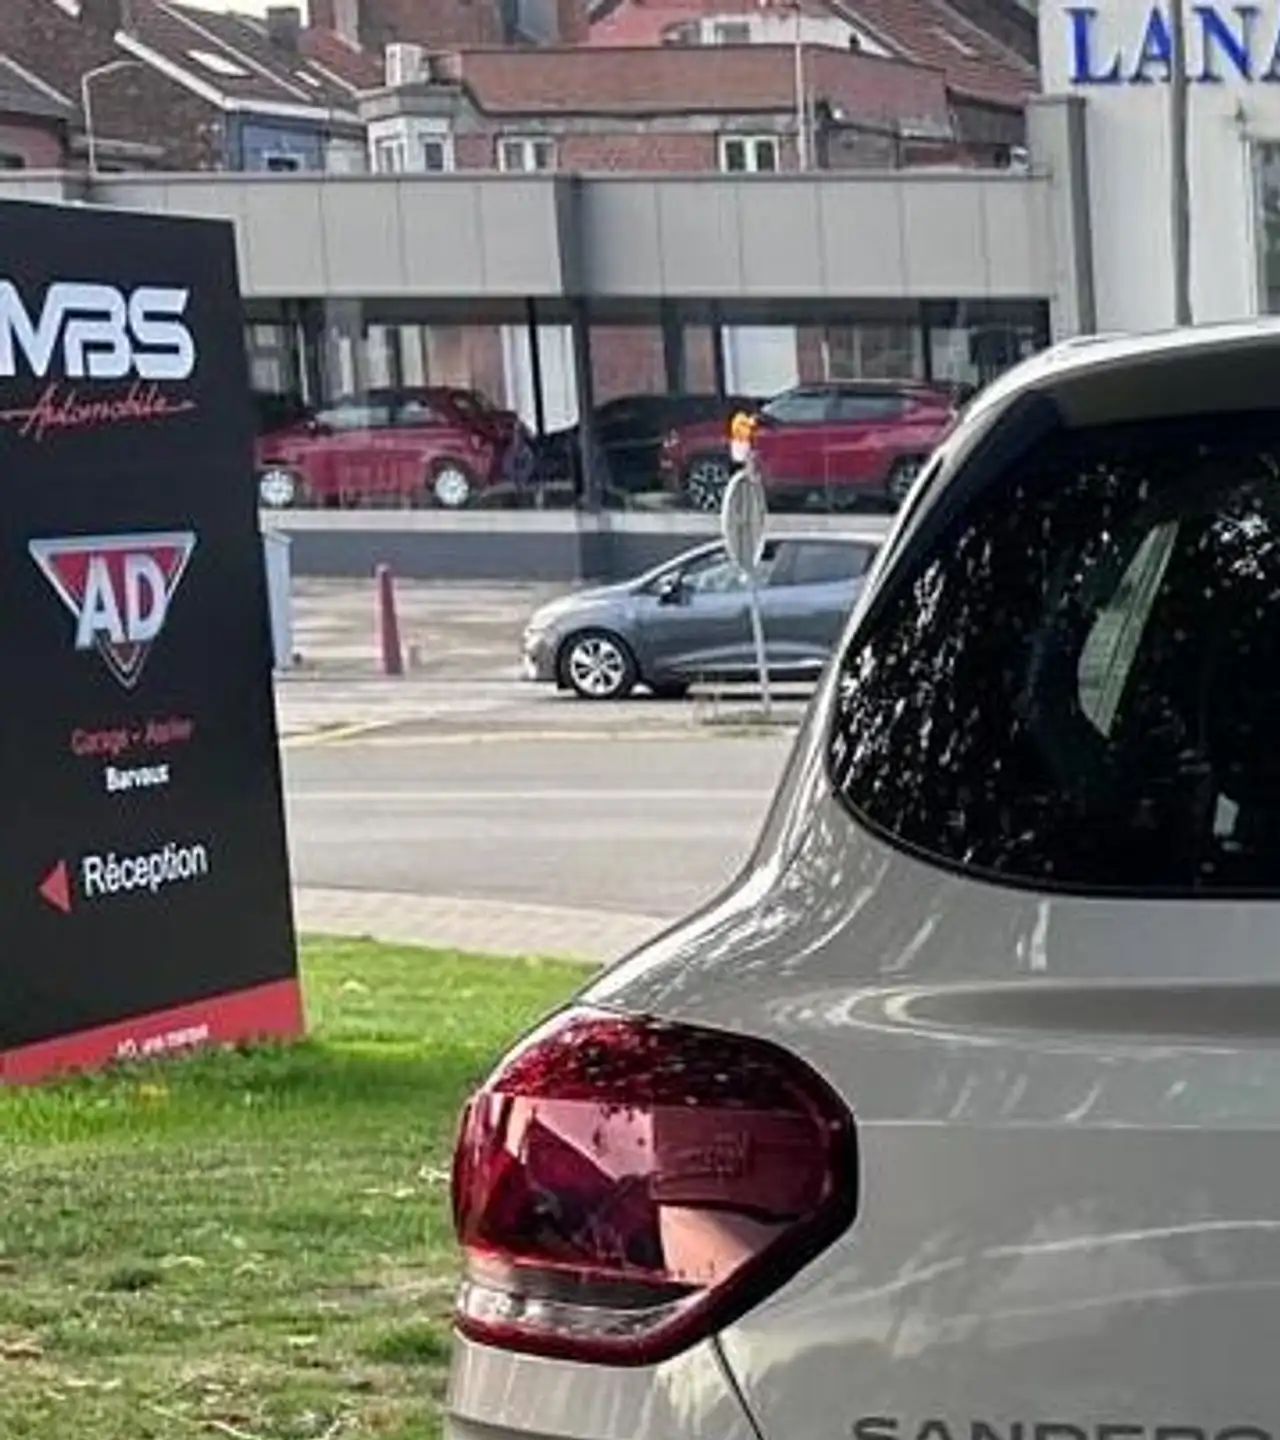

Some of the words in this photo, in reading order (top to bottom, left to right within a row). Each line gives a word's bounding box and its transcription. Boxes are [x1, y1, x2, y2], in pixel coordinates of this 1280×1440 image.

[0, 280, 195, 380] MBS
[75, 553, 168, 651] AD
[82, 842, 209, 897] Réception
